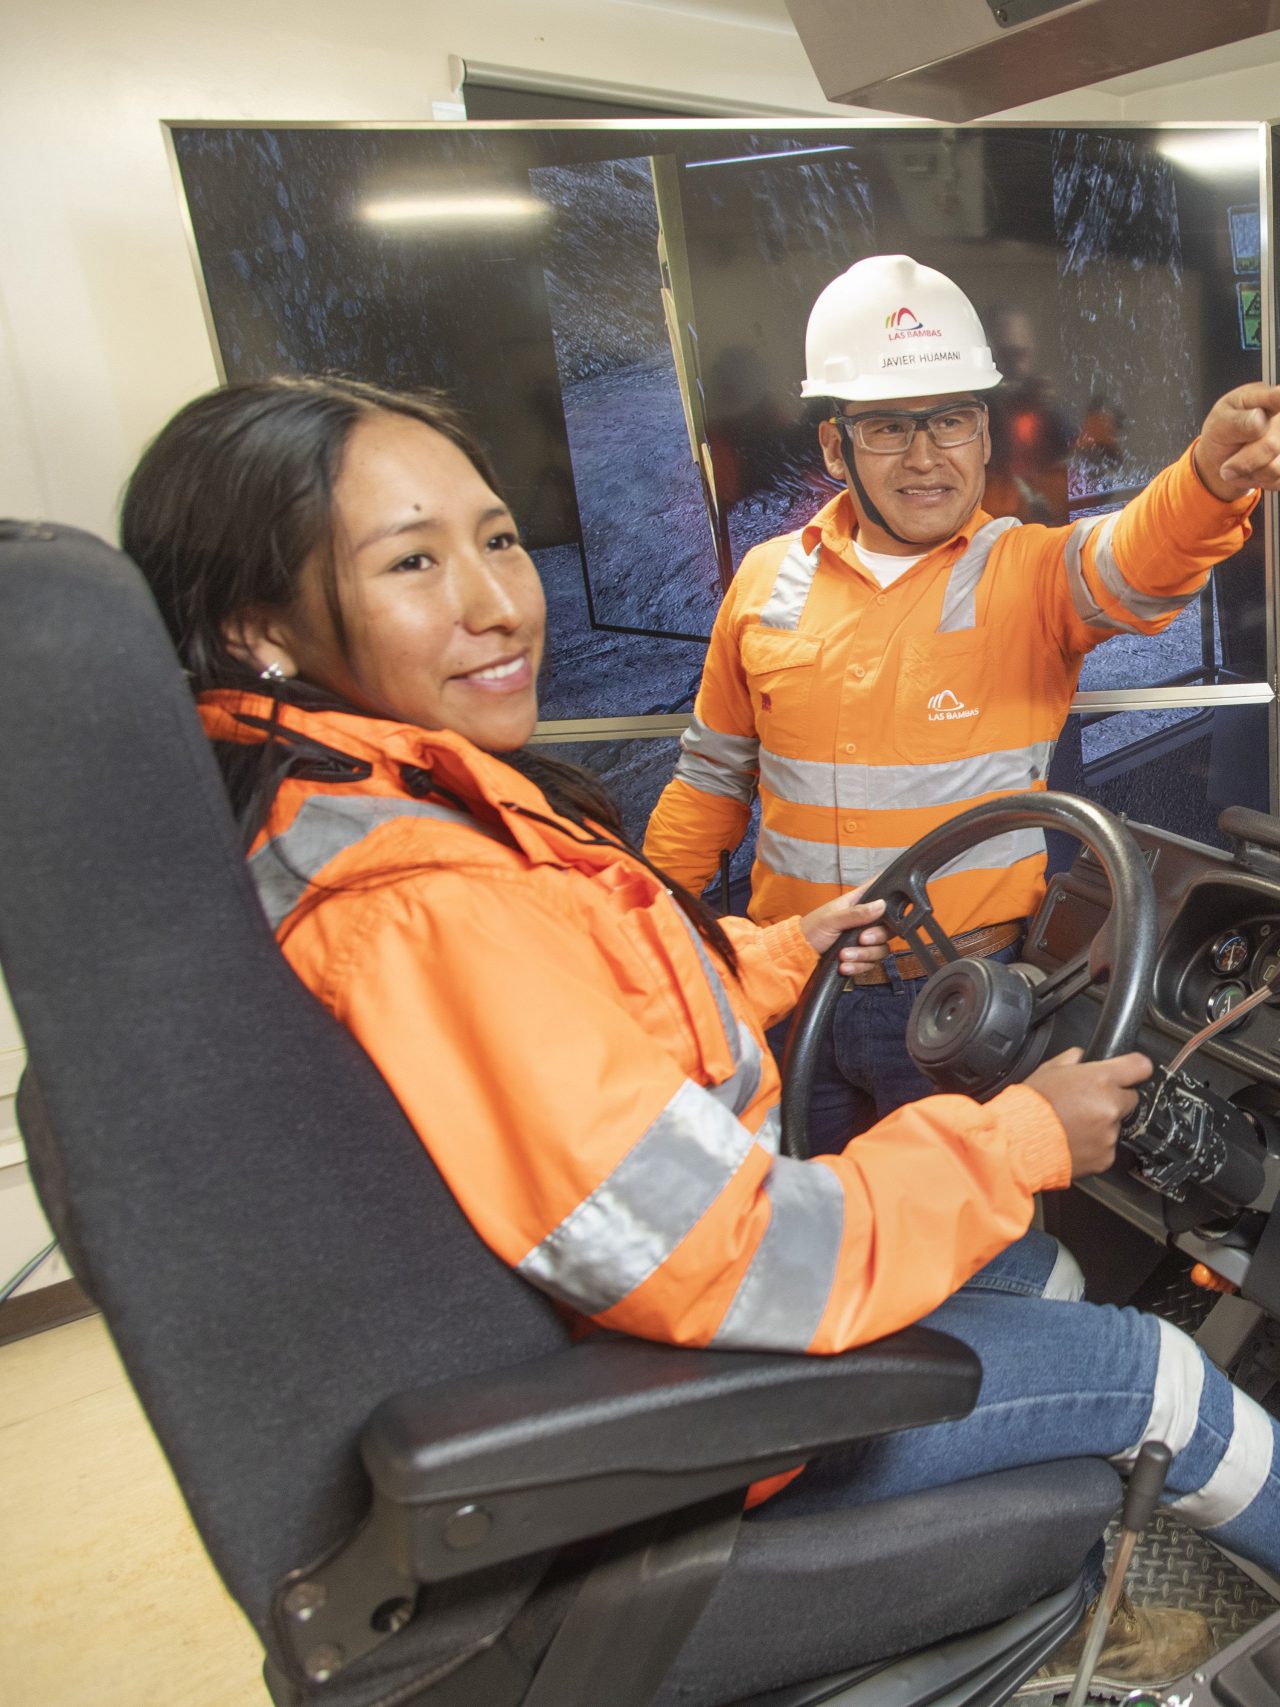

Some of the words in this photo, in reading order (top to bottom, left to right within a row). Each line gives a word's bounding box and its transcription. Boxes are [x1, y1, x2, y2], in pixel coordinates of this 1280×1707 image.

[888, 332, 905, 341] LAS
[907, 329, 942, 338] BAMBAS
[881, 355, 915, 368] JAVIER
[919, 351, 961, 363] HUAMANI
[928, 712, 945, 721] LAS
[946, 707, 980, 720] BAMBAS
